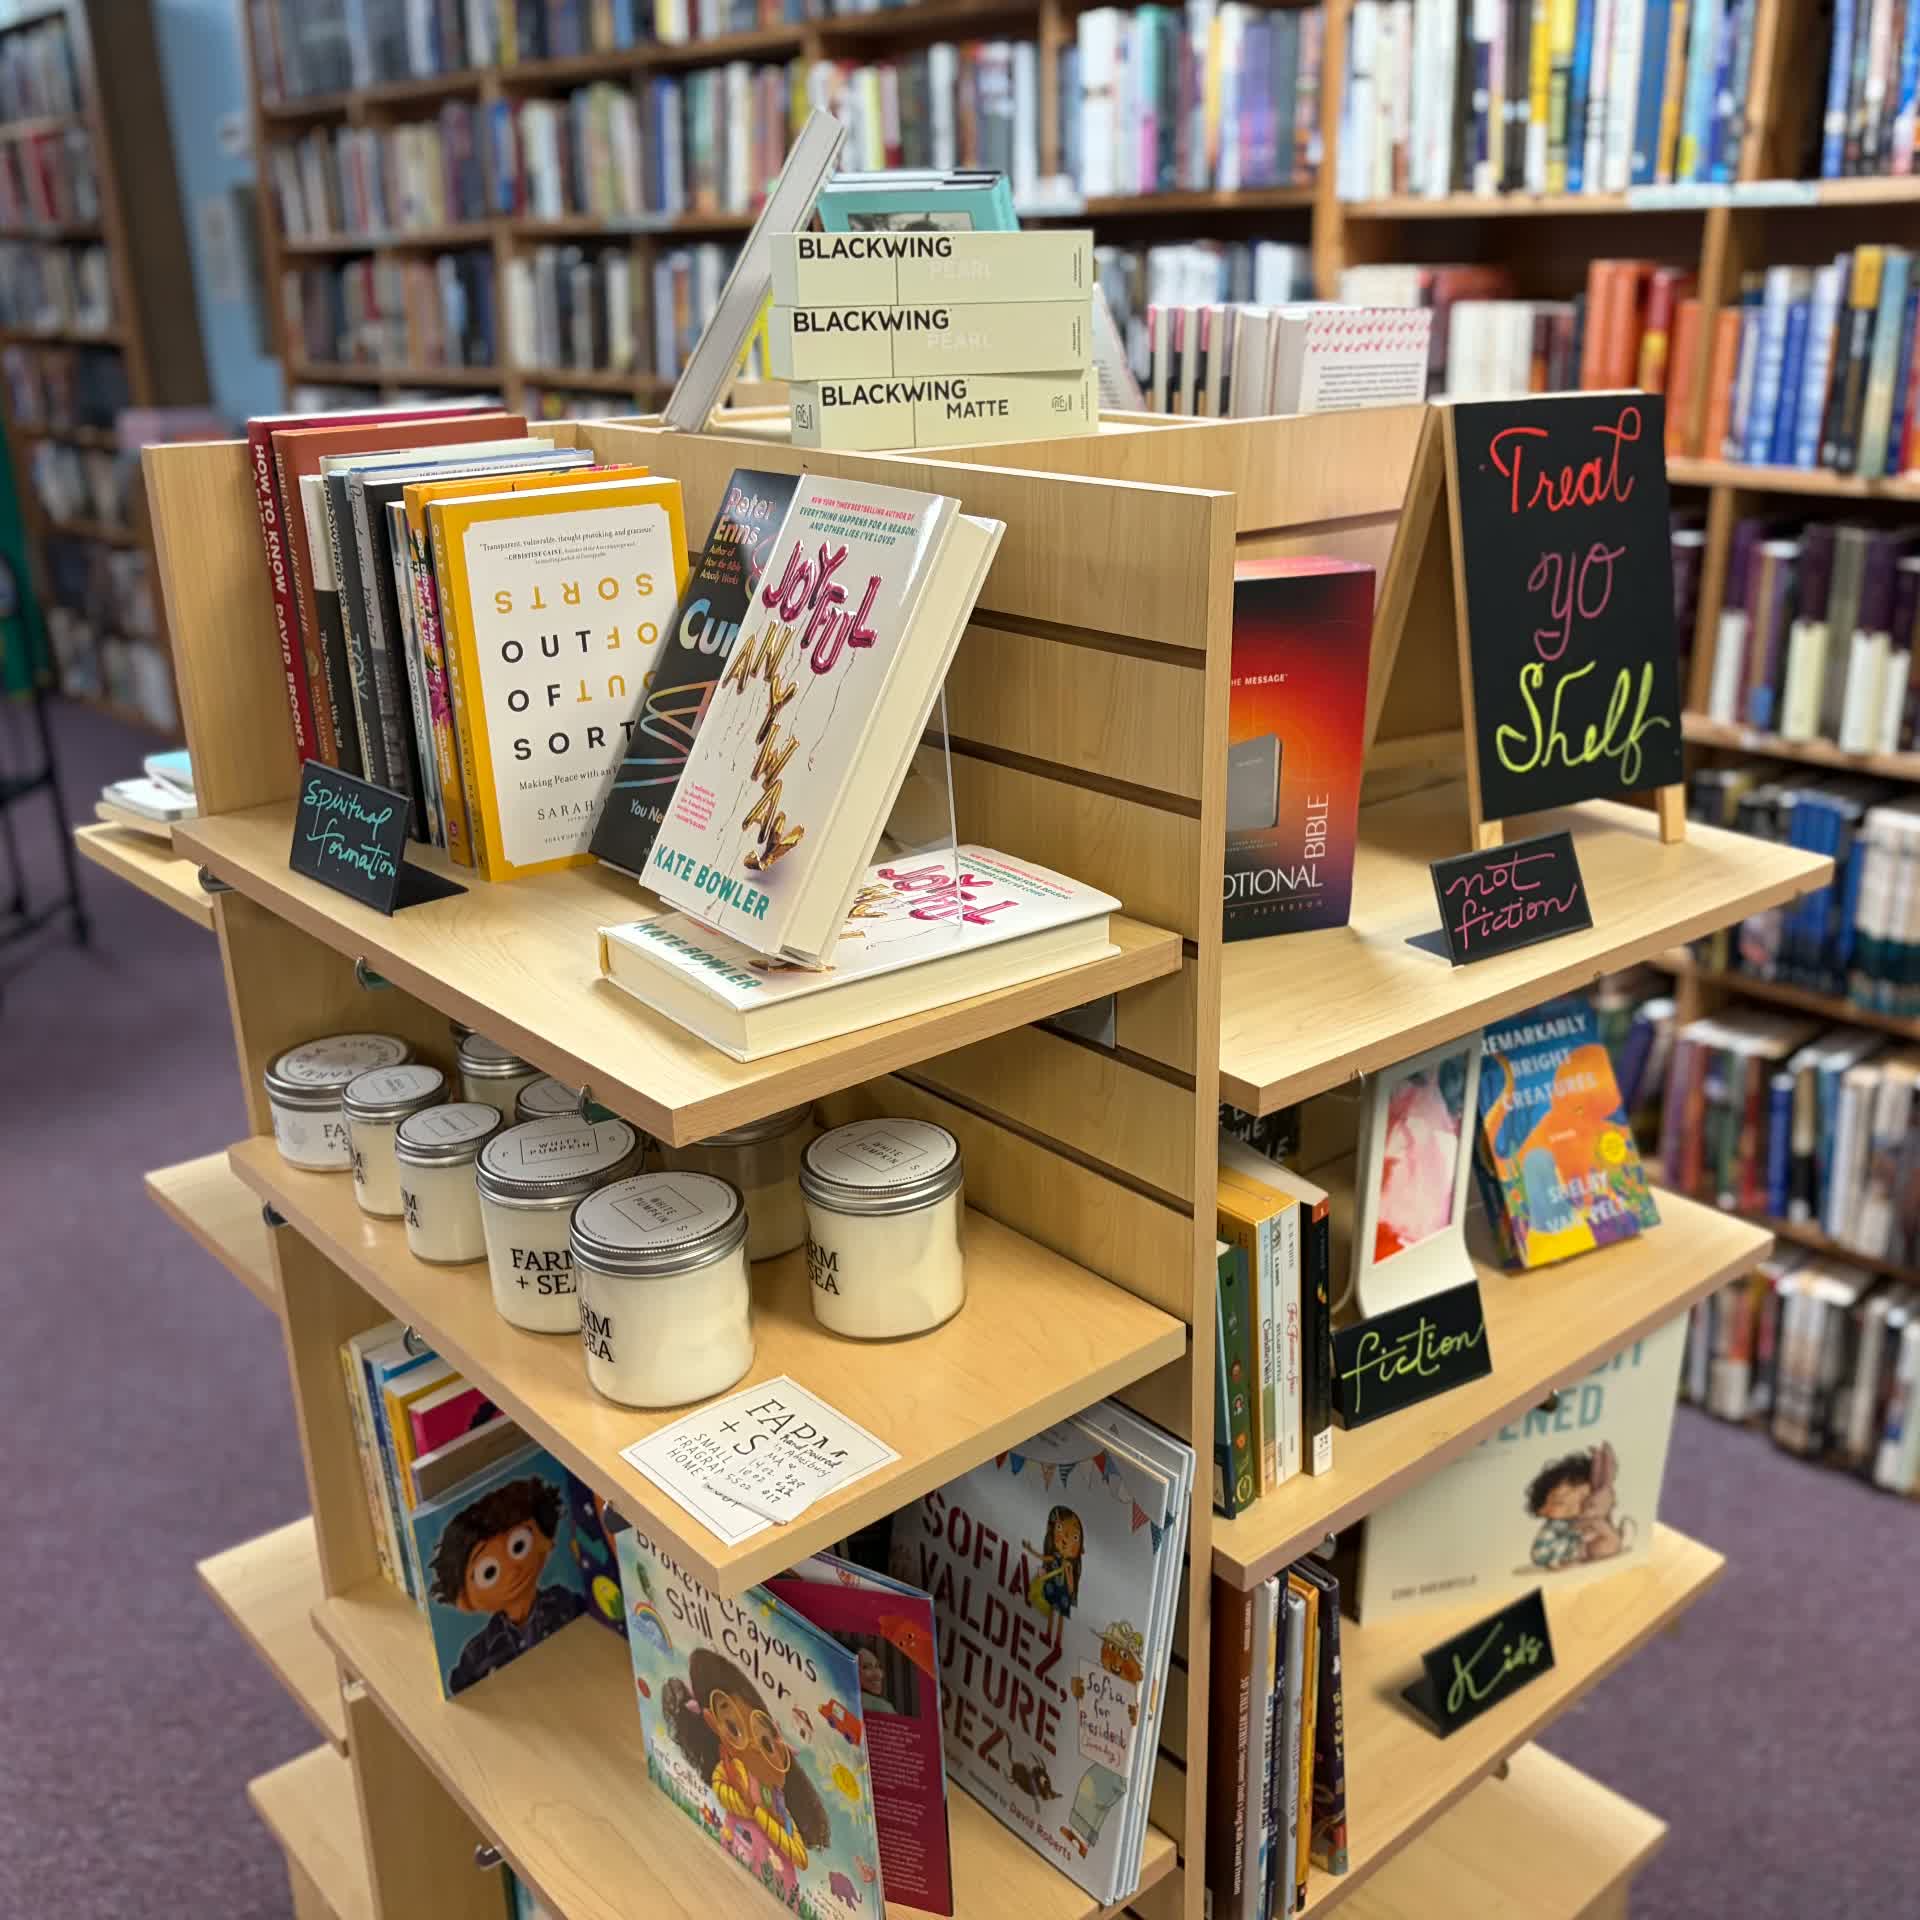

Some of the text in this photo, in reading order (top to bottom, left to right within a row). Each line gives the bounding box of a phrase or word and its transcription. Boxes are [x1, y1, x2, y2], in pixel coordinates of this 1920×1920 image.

[798, 236, 952, 259] BLACKWING
[793, 309, 949, 332] BLACKWING
[821, 379, 968, 406] BLACKWING
[946, 400, 1008, 419] MATTE
[1490, 406, 1641, 513] Treat
[255, 443, 286, 594] HOW TO KNOW
[724, 487, 777, 520] Peter
[800, 506, 888, 531] EVERYTHING HAPPENS FOR A
[811, 496, 915, 521] NEW YORK TIMES BESTSELLING AUTHOR OF
[713, 514, 761, 545] Enns
[809, 521, 897, 545] AND OTHER LIES I'VE LOVED
[709, 544, 727, 556] Author
[414, 527, 442, 684] GOD DIDN'T MAKE US
[429, 523, 446, 574] OUT
[445, 630, 464, 707] SORTS
[762, 539, 884, 675] JOYFUL
[501, 629, 592, 664] OUT
[275, 601, 305, 748] DAVID BROOKS
[1244, 673, 1286, 686] MESSAGE
[406, 654, 426, 741] MORRISON
[508, 683, 562, 713] OF
[1496, 661, 1671, 784] Shelf
[519, 777, 553, 791] Making
[554, 774, 578, 785] Peace
[579, 770, 599, 780] with
[304, 779, 393, 840] Spiritual
[537, 800, 594, 821] SARAH
[630, 798, 647, 818] You
[1304, 793, 1329, 859] BIBLE
[306, 818, 397, 881] formation
[653, 843, 697, 883] KATE
[693, 863, 770, 921] BOWLER
[1446, 851, 1556, 897] not
[1454, 883, 1578, 950] fiction
[634, 922, 763, 990] KATE BOWLER
[1510, 1047, 1572, 1077] BRIGHT
[1502, 1070, 1598, 1111] CREATURES
[529, 1142, 590, 1156] PUMPKIN
[538, 1138, 578, 1148] WHITE
[855, 1142, 899, 1164] PUMPKIN
[808, 1238, 839, 1272] RM
[537, 1273, 577, 1294] SE
[580, 1301, 612, 1339] RM
[1341, 1316, 1484, 1413] fiction
[665, 1447, 705, 1477] HOME
[694, 1432, 734, 1464] SMALL
[922, 1488, 1033, 1608] SOFIA
[665, 1587, 792, 1701] Still Color
[720, 1596, 818, 1684] Crayons
[1447, 1621, 1545, 1713] Kids
[1086, 1671, 1126, 1705] Sofia
[1008, 1801, 1036, 1830] David
[1035, 1823, 1072, 1862] Roberts
